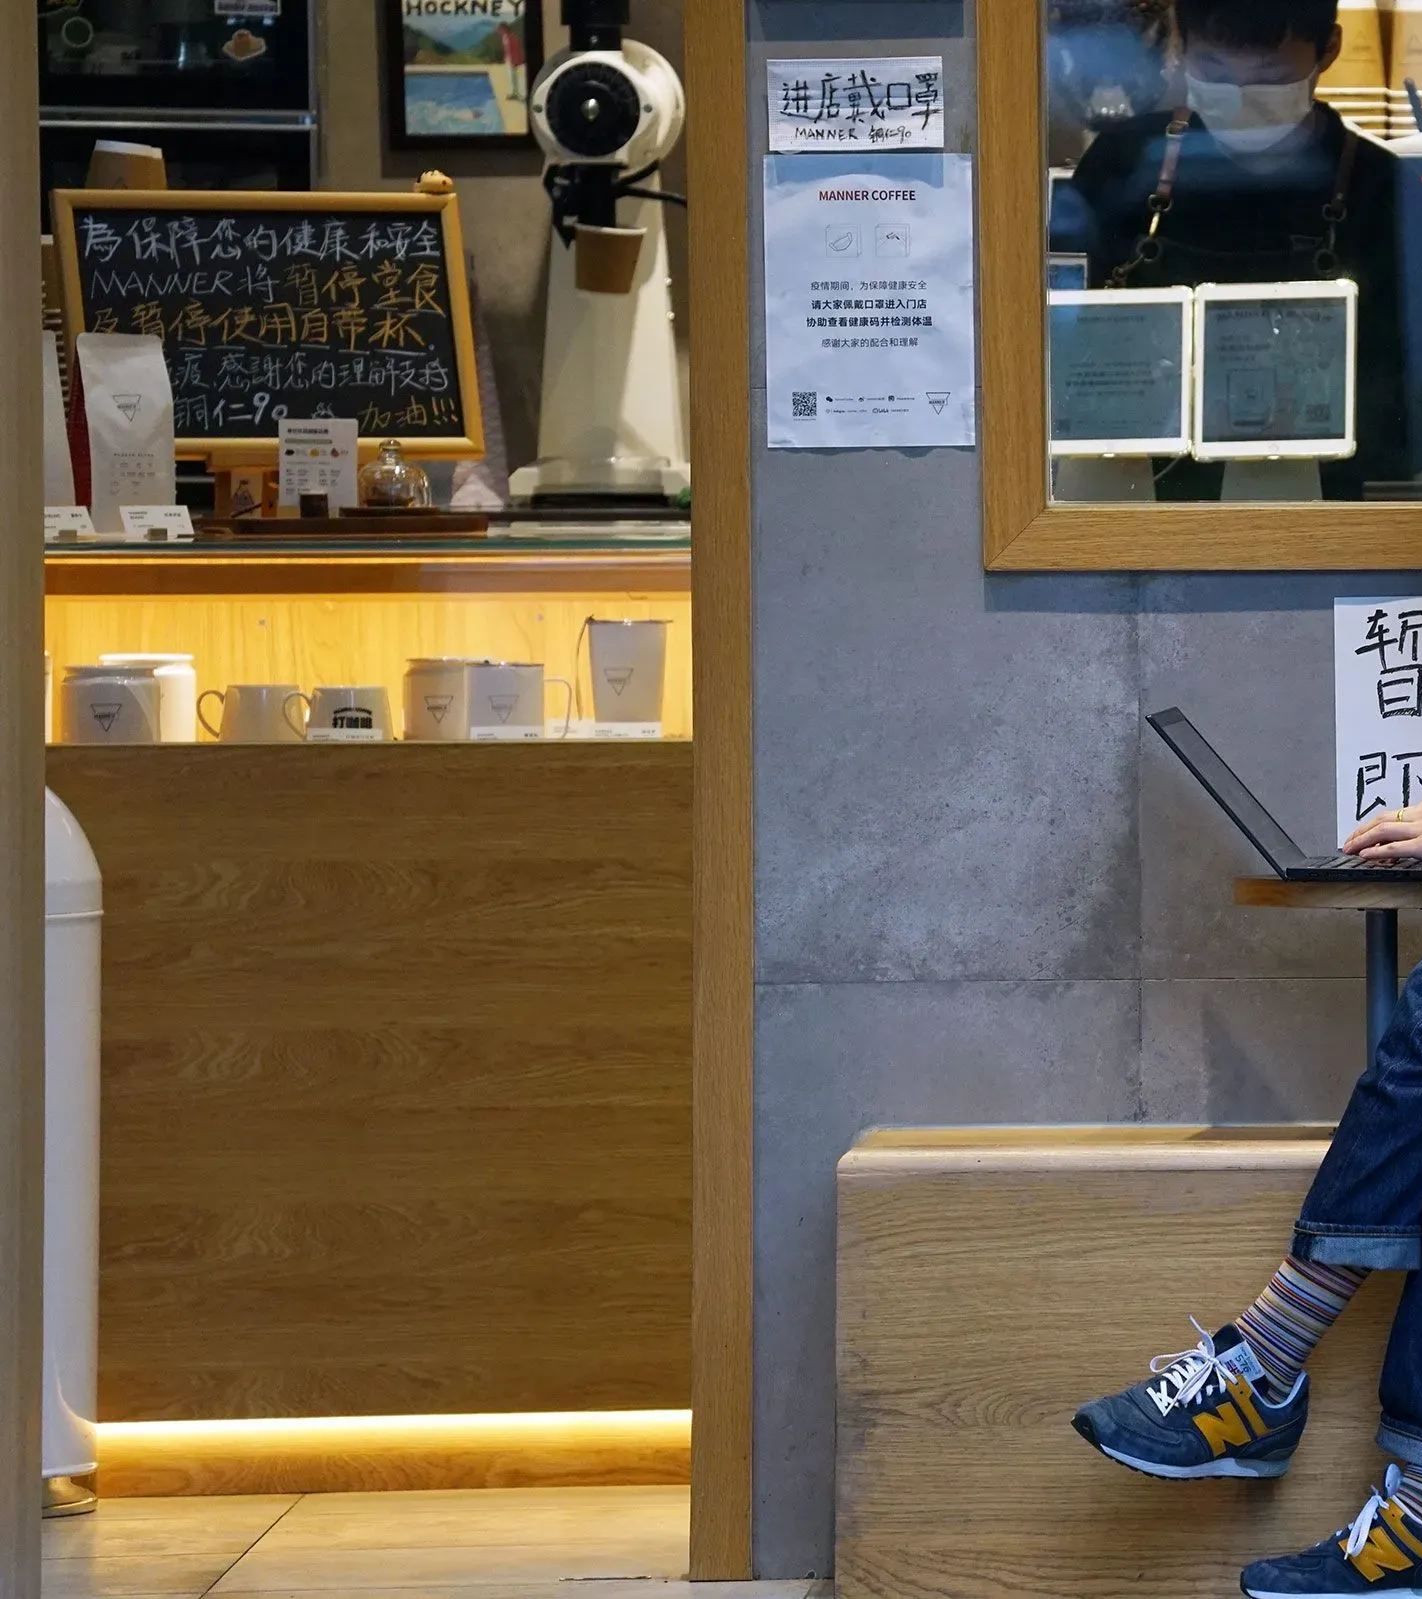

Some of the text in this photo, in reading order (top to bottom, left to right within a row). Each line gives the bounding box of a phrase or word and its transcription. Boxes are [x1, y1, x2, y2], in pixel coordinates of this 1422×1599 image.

[405, 0, 526, 16] HOCKNEY
[780, 70, 943, 130] 进店戴口罩
[795, 127, 858, 141] MANNER
[819, 190, 916, 201] MANNER COFFEE
[90, 269, 233, 300] MANNER
[811, 299, 928, 310] 请大家佩戴口罩进入门店
[806, 316, 933, 328] 协助查看健康码并检测体温
[821, 337, 919, 348] 感谢大家的配合和理解
